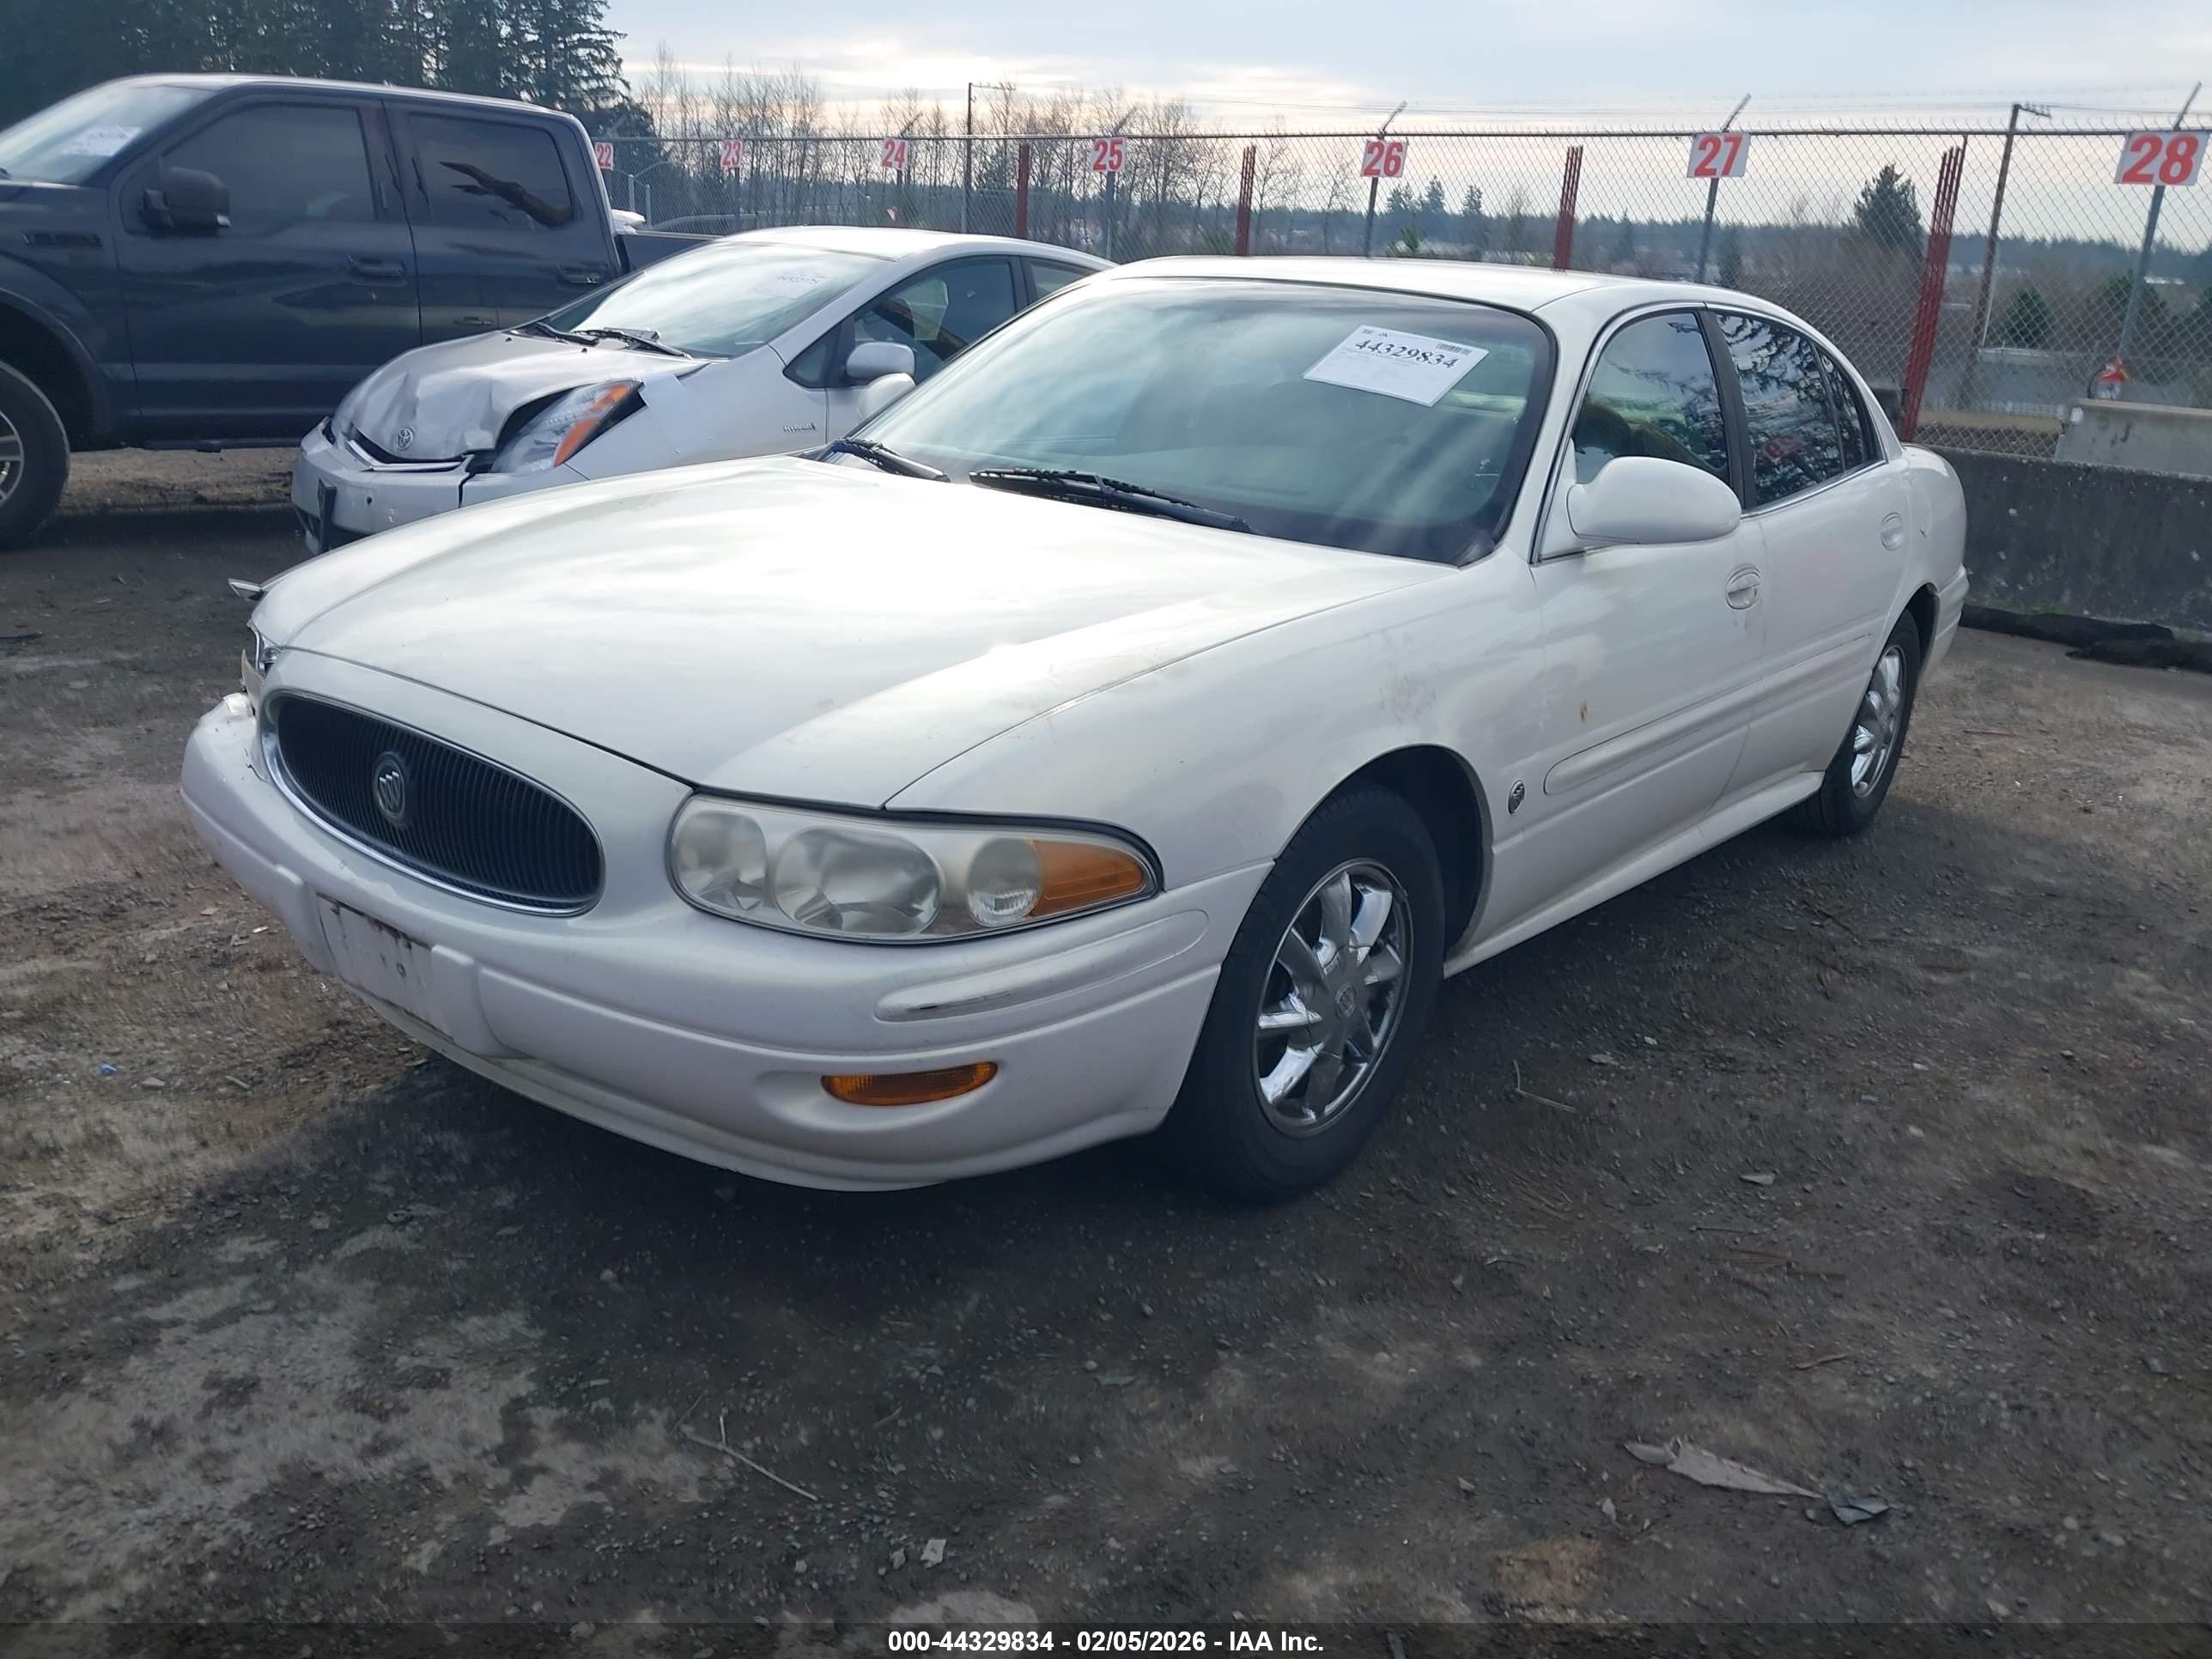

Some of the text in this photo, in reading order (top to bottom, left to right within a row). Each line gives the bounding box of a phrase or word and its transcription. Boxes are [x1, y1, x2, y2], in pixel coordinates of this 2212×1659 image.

[596, 143, 611, 167] 22
[722, 140, 742, 166] 23
[882, 138, 906, 169] 24
[1093, 137, 1123, 171] 25
[1364, 141, 1403, 177] 26
[1693, 134, 1743, 177] 27
[2122, 133, 2199, 185] 28
[1355, 339, 1460, 368] 44329834
